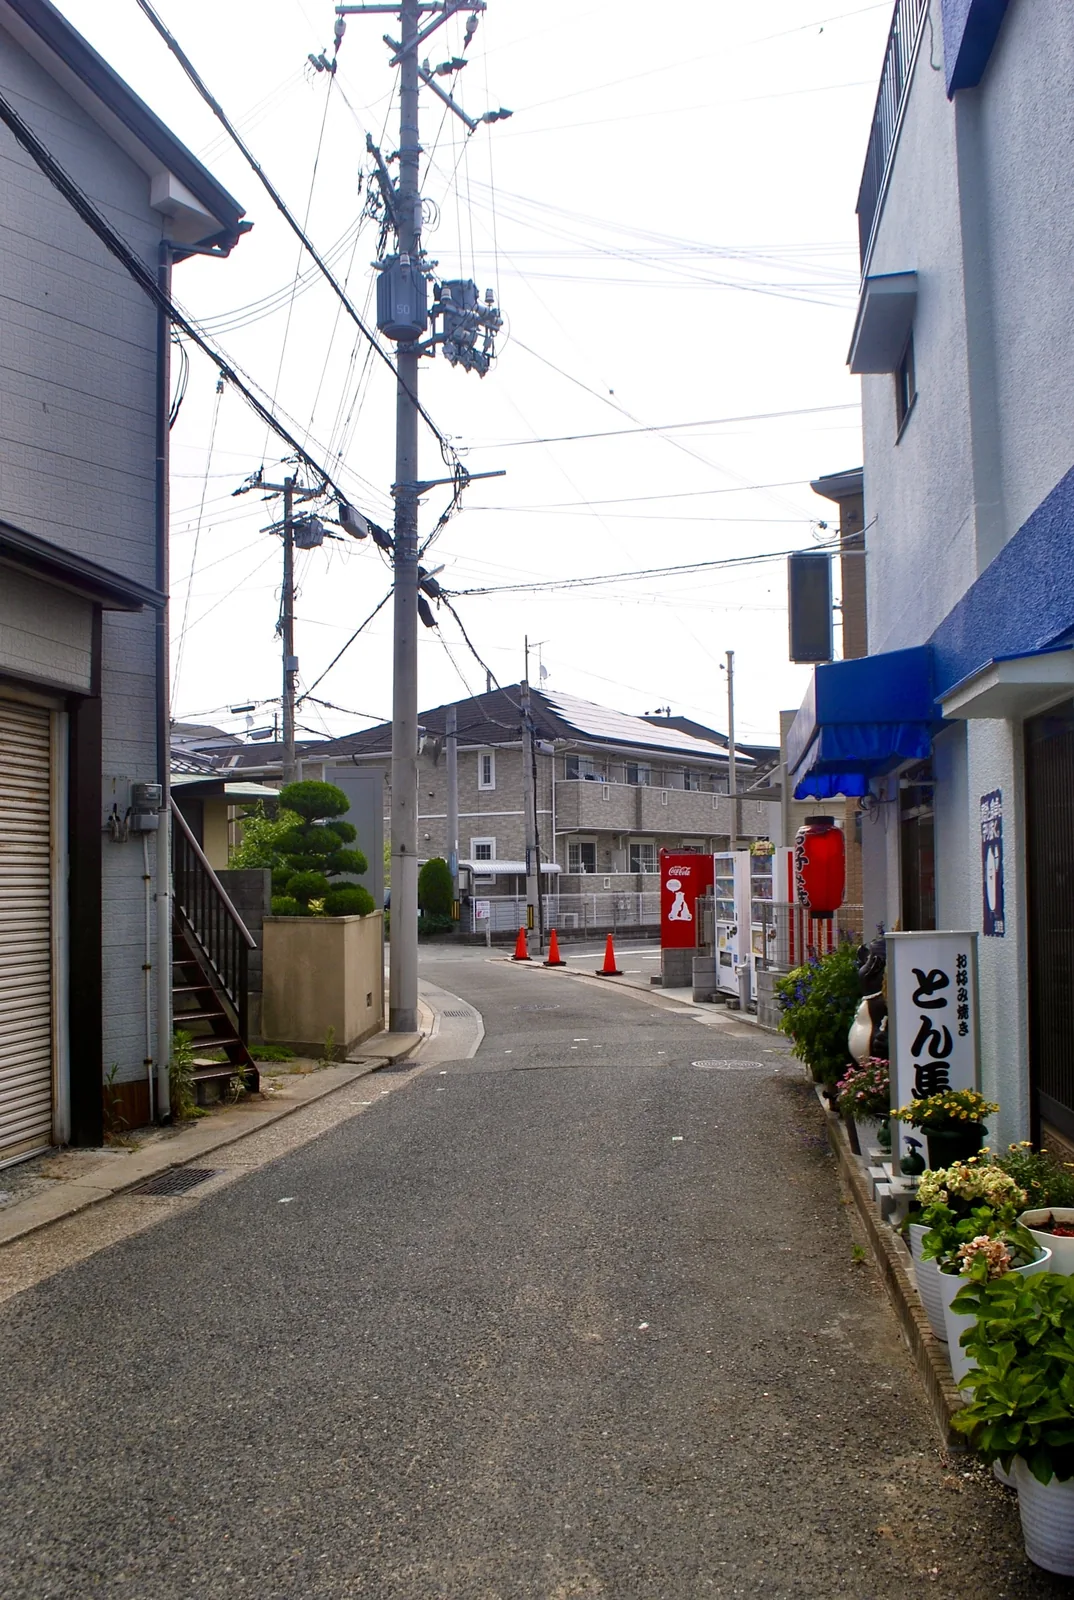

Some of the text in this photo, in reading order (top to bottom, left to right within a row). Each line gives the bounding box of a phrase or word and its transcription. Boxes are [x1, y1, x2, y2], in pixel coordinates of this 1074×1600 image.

[396, 304, 410, 315] 50
[911, 968, 953, 1099] とん馬
[956, 953, 970, 1037] お好み焼き
